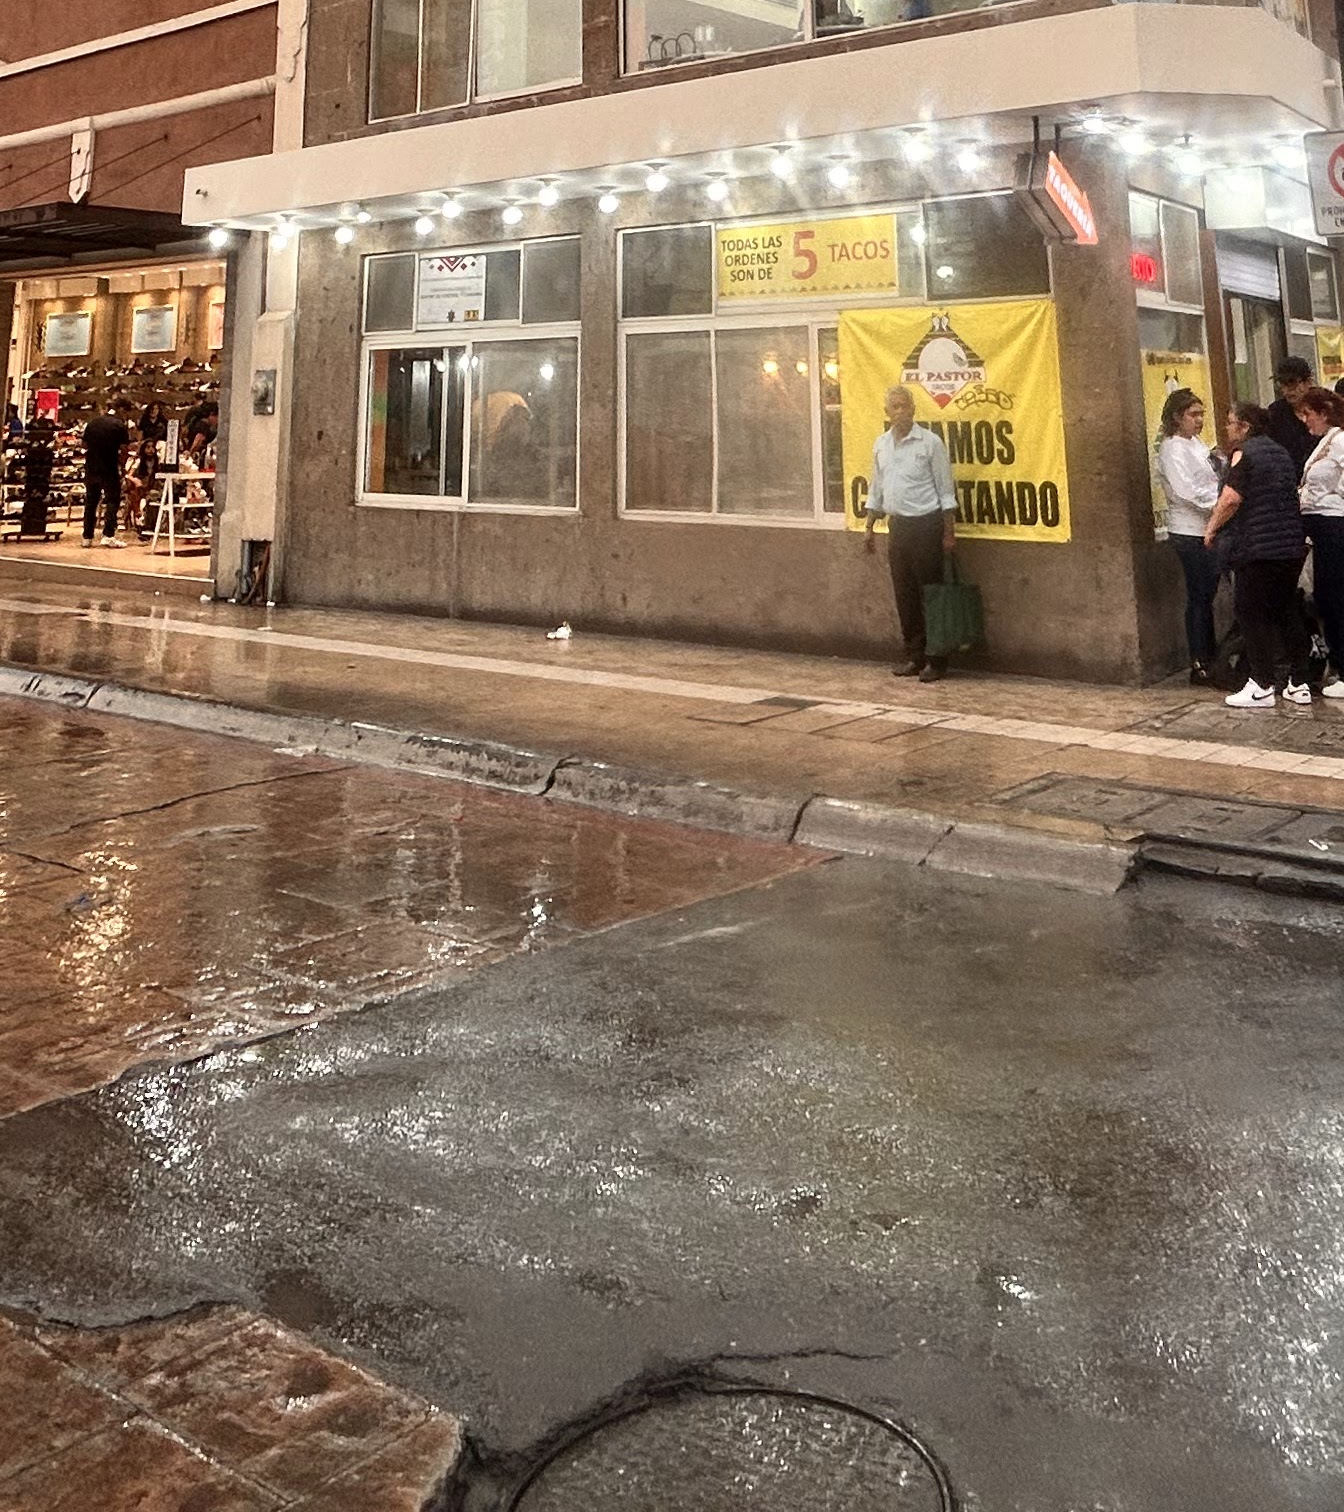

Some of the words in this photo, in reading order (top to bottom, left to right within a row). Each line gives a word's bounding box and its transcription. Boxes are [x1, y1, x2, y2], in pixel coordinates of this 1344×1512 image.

[721, 237, 758, 253] TODAS
[762, 236, 783, 249] LAS
[724, 251, 779, 267] ORDENES
[791, 230, 818, 280] 5
[827, 240, 891, 263] TACOS
[730, 269, 754, 282] SON
[758, 267, 774, 280] DE
[904, 372, 925, 382] EL
[926, 371, 983, 382] PASTOR
